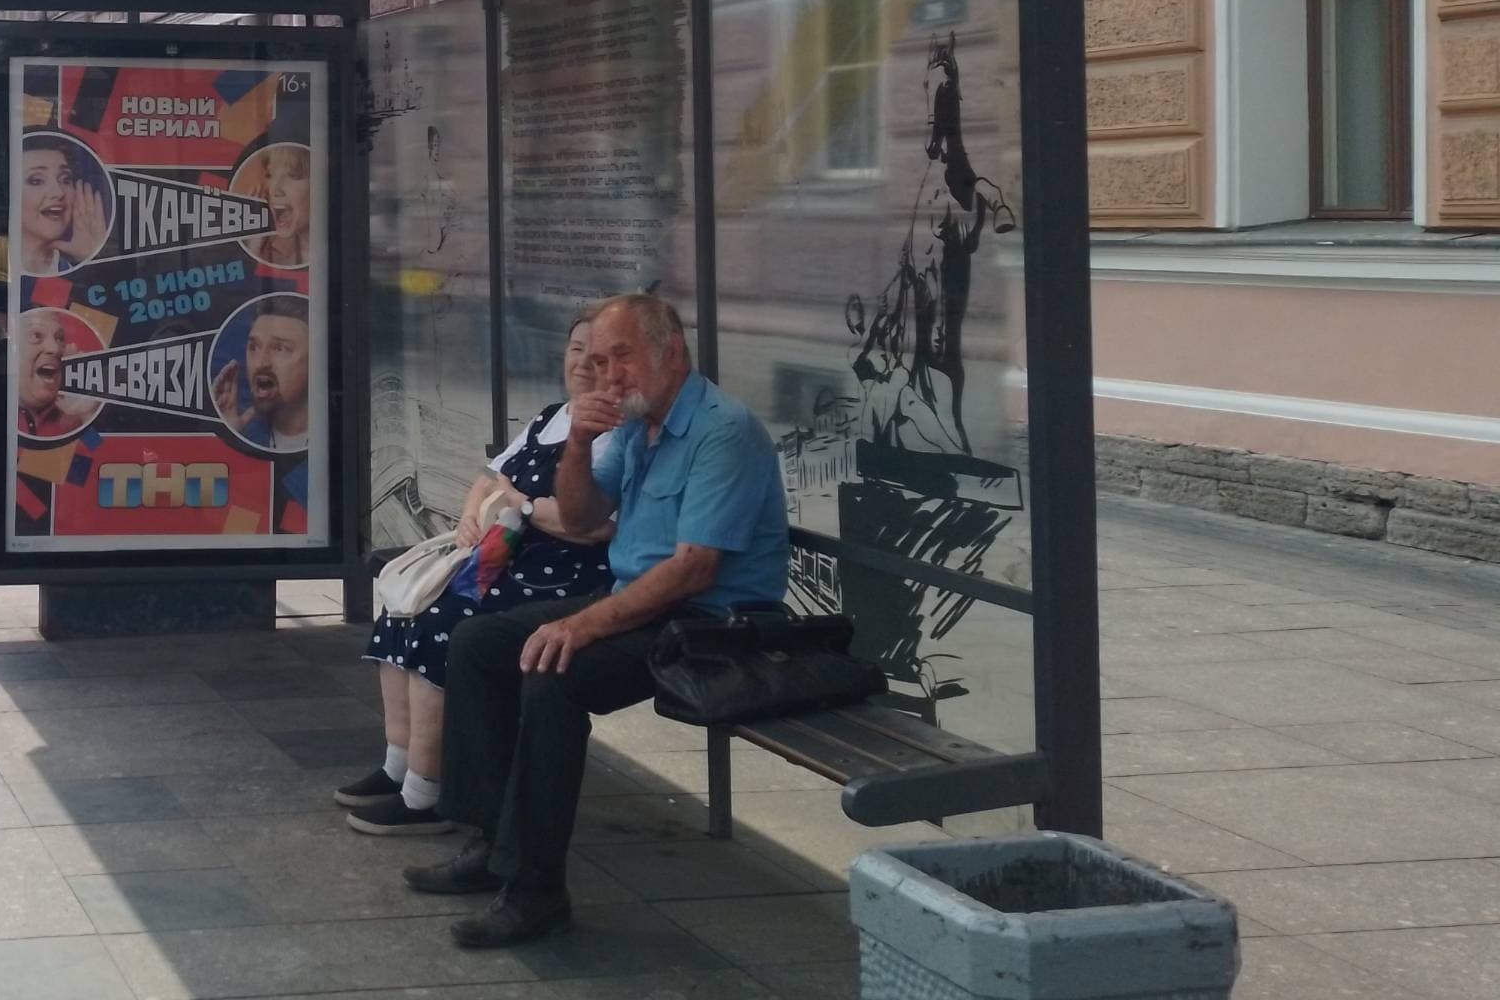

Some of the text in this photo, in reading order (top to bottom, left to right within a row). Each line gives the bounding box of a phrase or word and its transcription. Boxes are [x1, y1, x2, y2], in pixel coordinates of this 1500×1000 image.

[278, 74, 307, 93] 16+
[121, 95, 216, 116] НОВЫЙ
[116, 117, 220, 139] СЕРИАЛ
[117, 178, 269, 250] ТКАЧЁВЫ
[87, 259, 245, 306] С 10 ИЮНЯ
[128, 290, 212, 324] 20:00
[65, 340, 204, 410] НА СВЯЗИ
[98, 462, 229, 508] ТНТ
